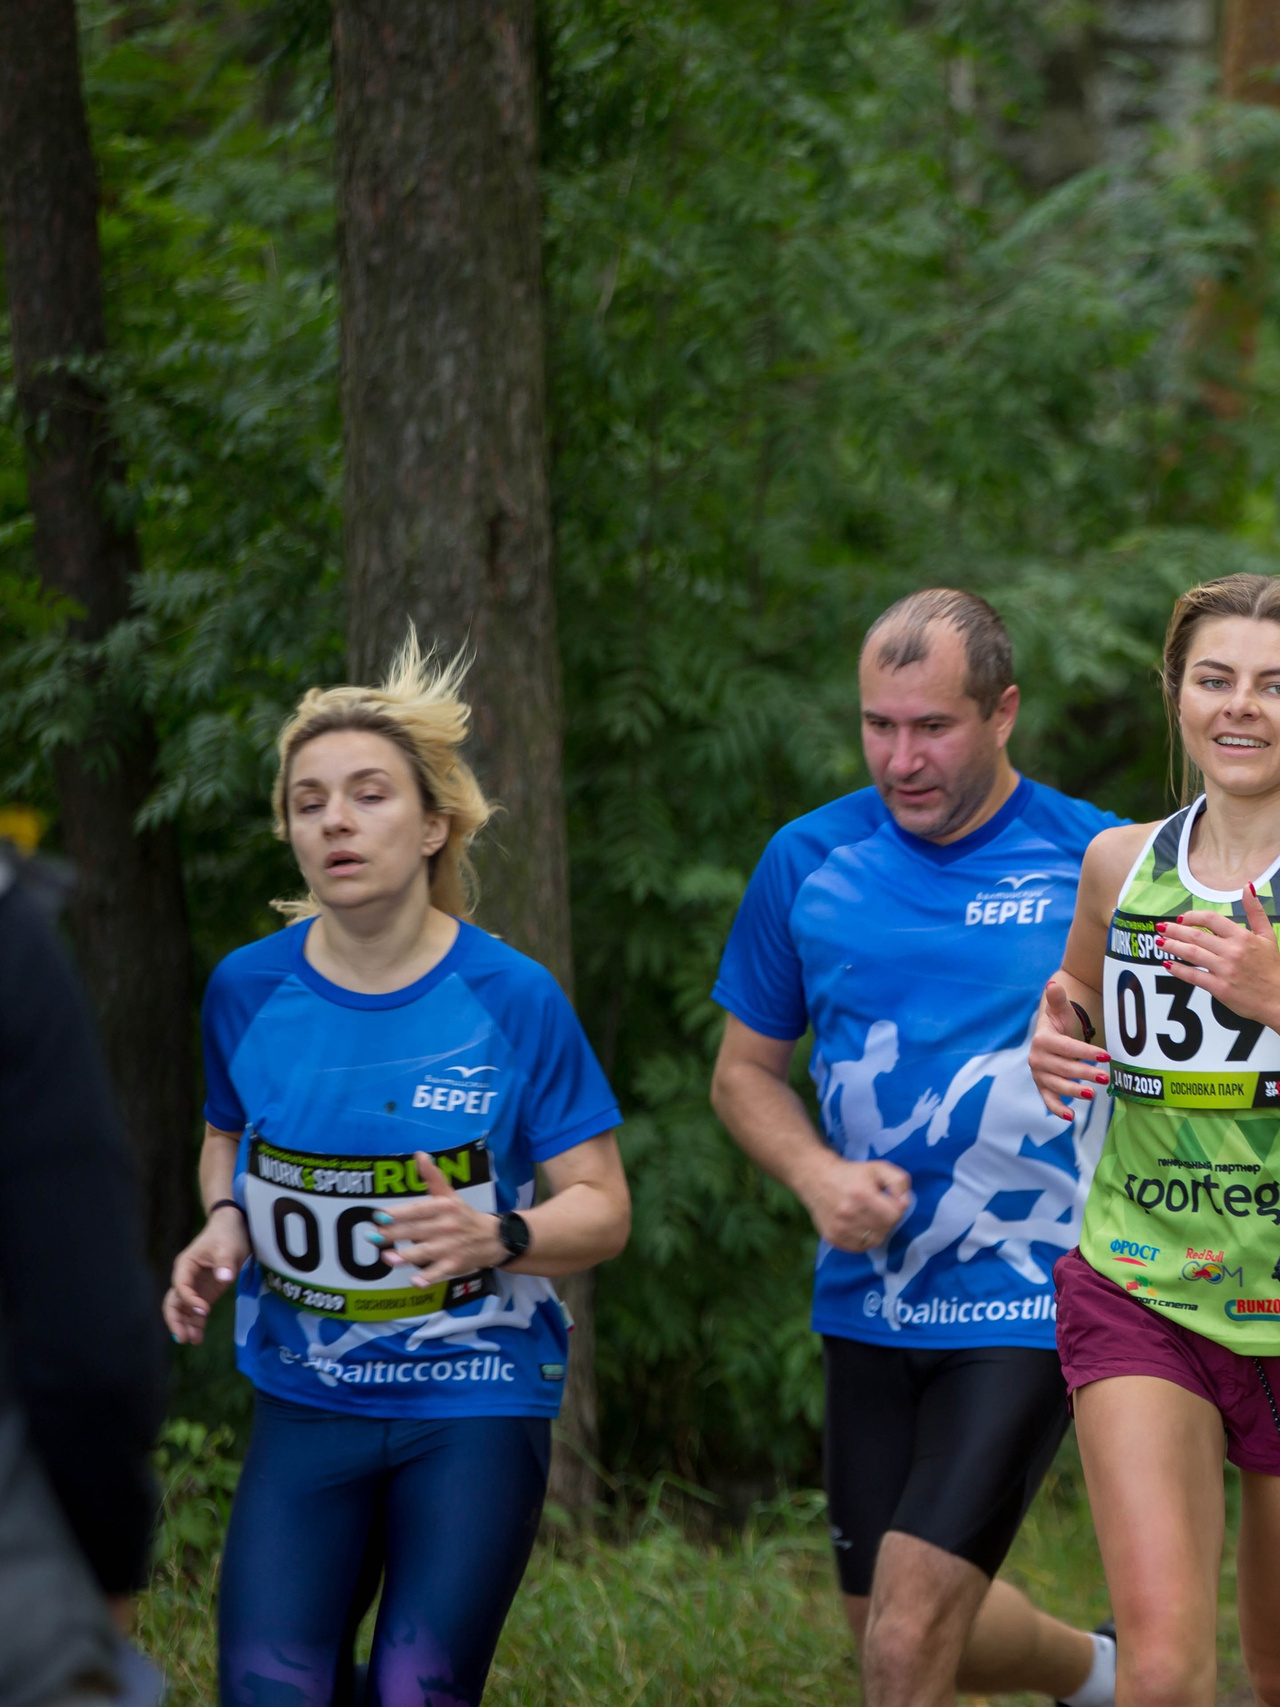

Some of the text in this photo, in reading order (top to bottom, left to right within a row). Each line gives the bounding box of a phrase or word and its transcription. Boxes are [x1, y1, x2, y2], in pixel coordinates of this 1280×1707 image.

[964, 899, 1053, 926] БЕРЕГ
[412, 1085, 498, 1114] БЕРЕГ
[1170, 1082, 1245, 1096] СОСНОВКА ПАРК
[1215, 1163, 1261, 1175] партнер
[1110, 1239, 1160, 1261] ФРОСТ
